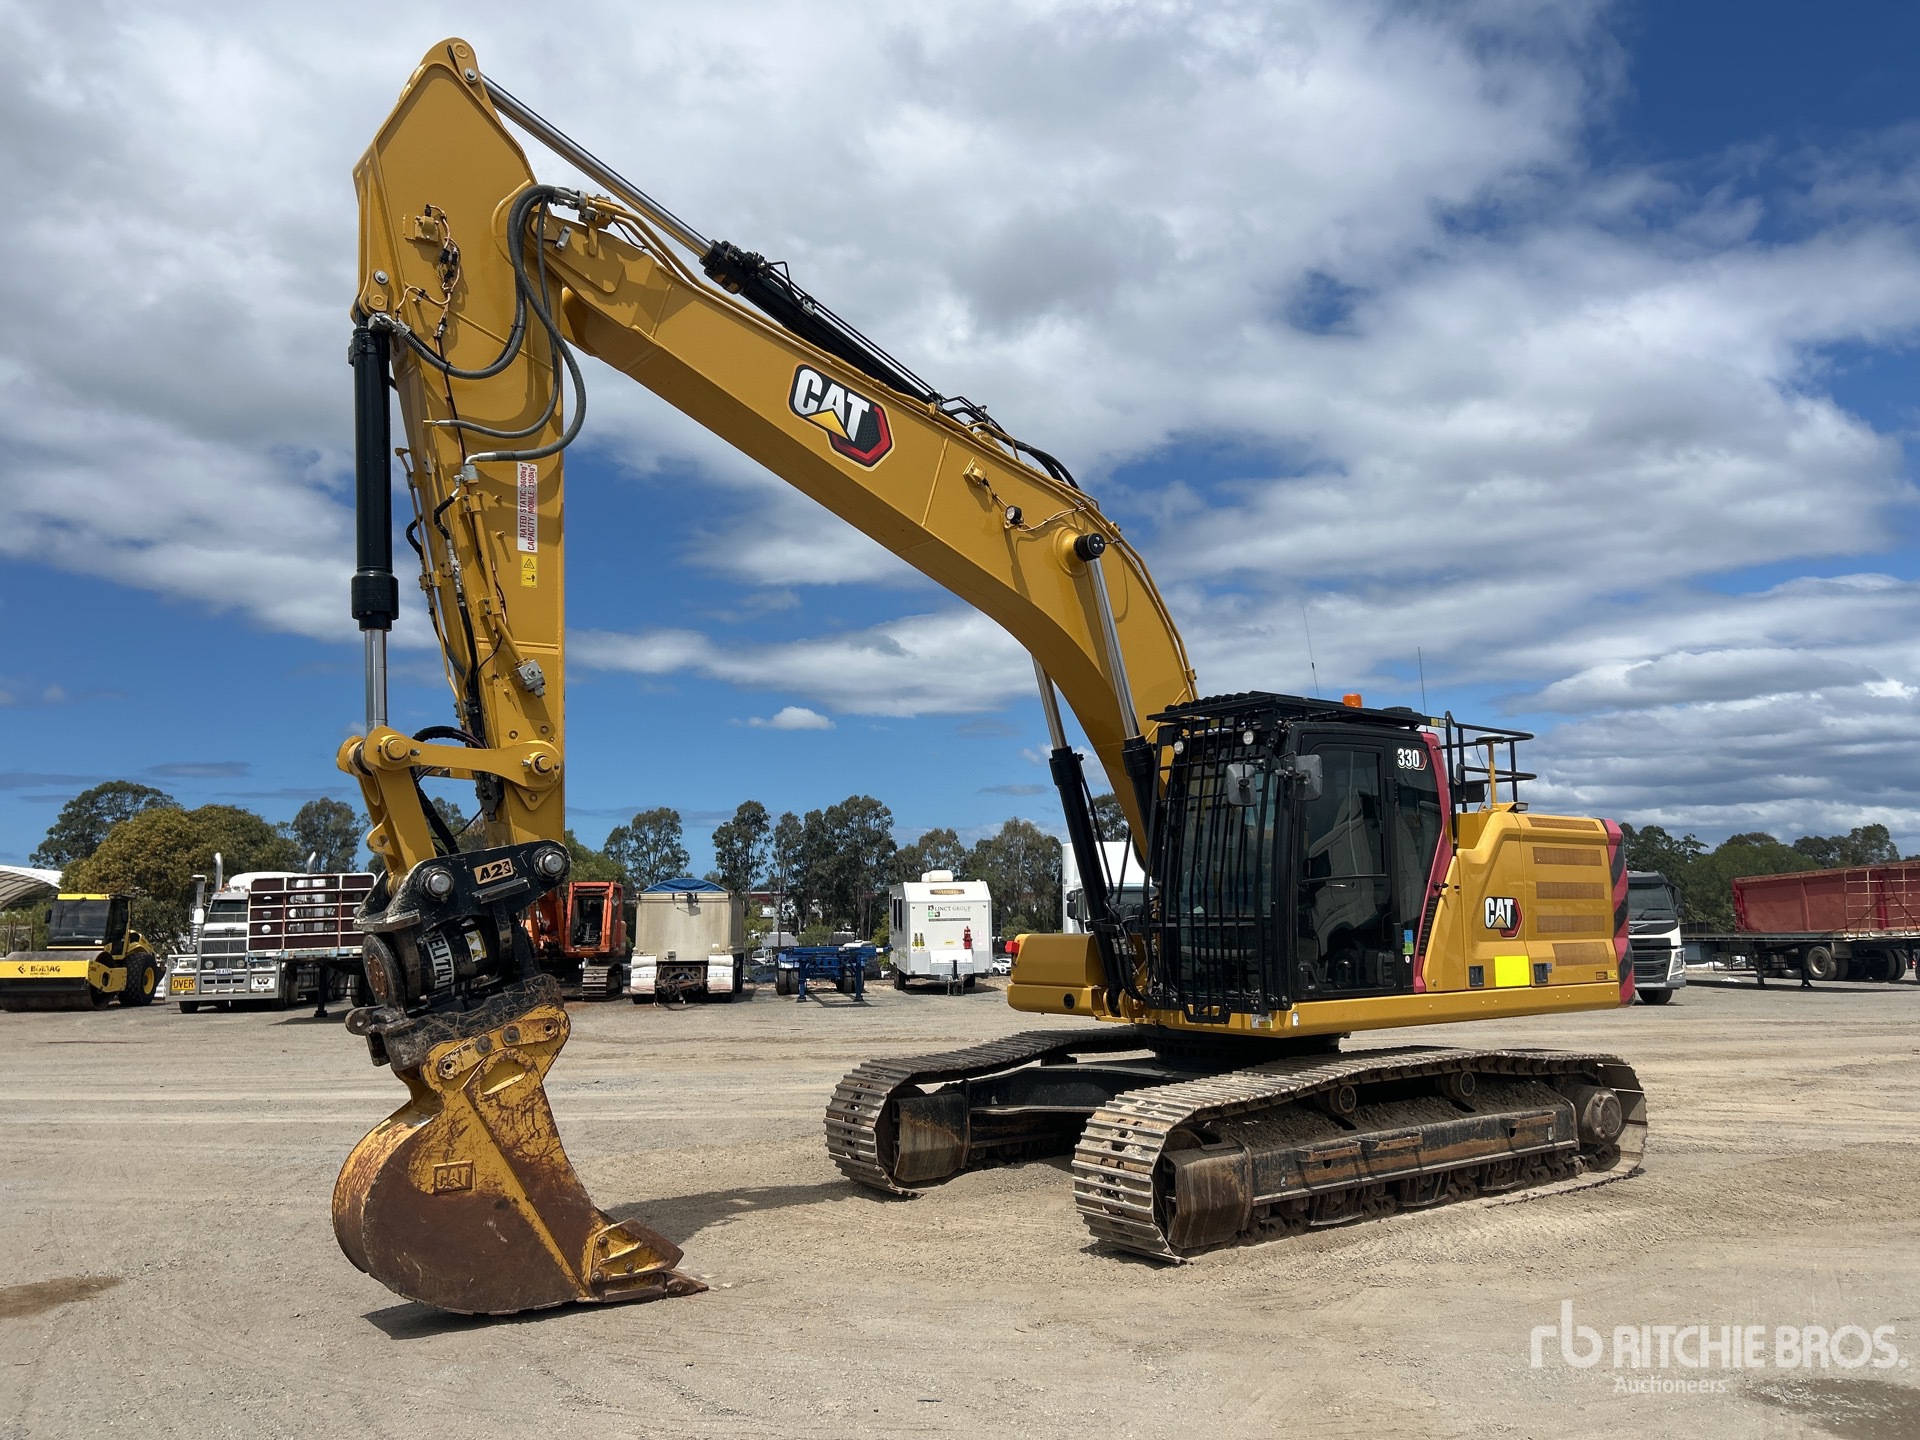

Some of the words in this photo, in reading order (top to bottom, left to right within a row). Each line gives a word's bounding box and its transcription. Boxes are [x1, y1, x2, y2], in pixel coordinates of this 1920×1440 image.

[793, 368, 871, 442] CAT
[519, 515, 527, 538] RATED
[527, 517, 535, 551] CAPACITY
[1397, 748, 1420, 768] 330
[1484, 897, 1514, 929] CAT
[173, 979, 194, 989] OVER
[436, 1167, 469, 1189] CAT
